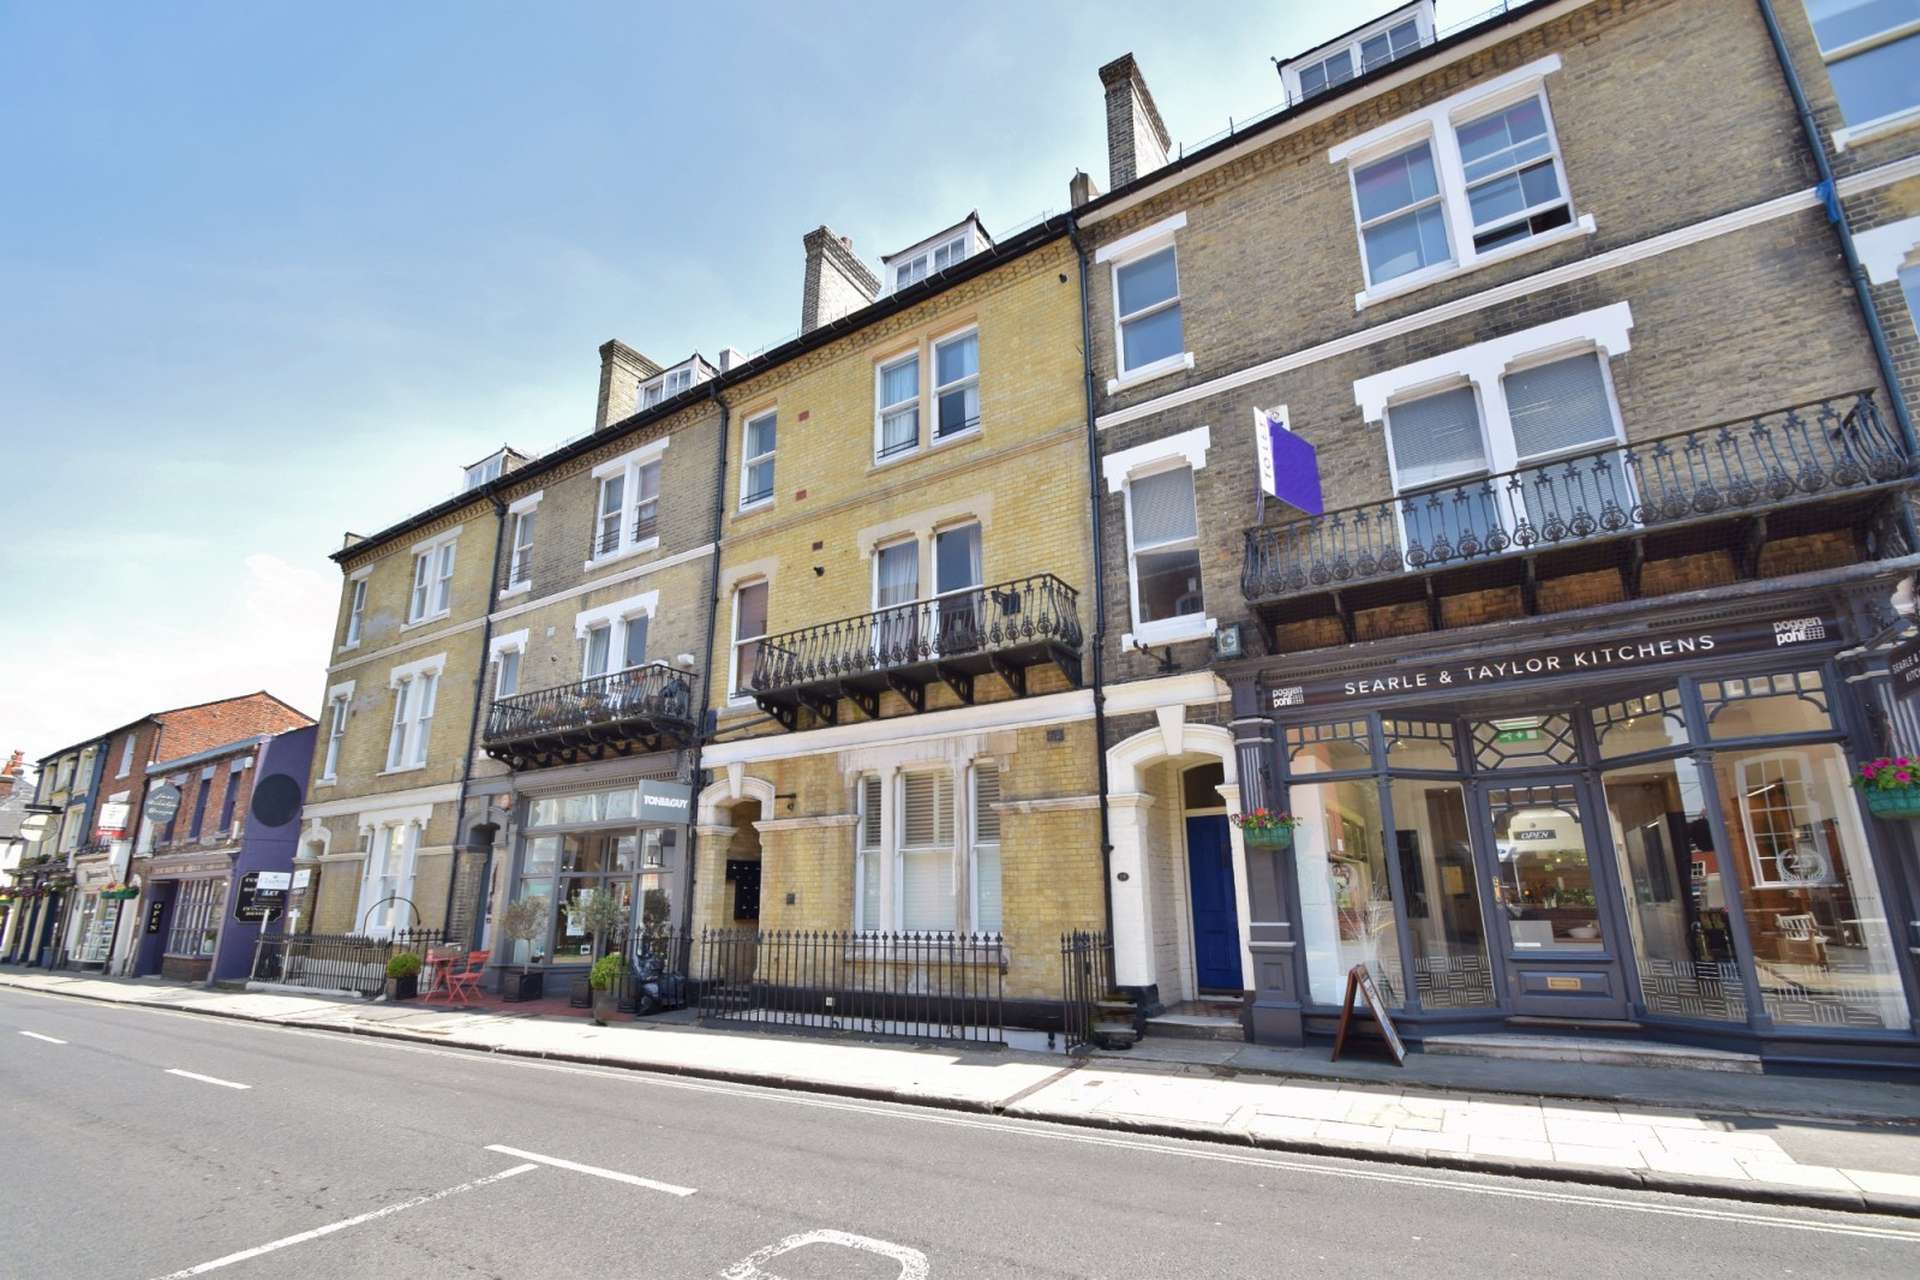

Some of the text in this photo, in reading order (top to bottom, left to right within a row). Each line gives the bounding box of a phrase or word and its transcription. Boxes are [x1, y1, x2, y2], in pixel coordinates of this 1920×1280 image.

[1773, 617, 1823, 634] poggen
[1776, 628, 1806, 646] pohl
[1345, 635, 1715, 695] SEARLE & TAYLOR KITCHENS
[643, 795, 688, 809] TONI&GUY
[1520, 831, 1549, 840] OPEN
[150, 903, 162, 932] OPEN
